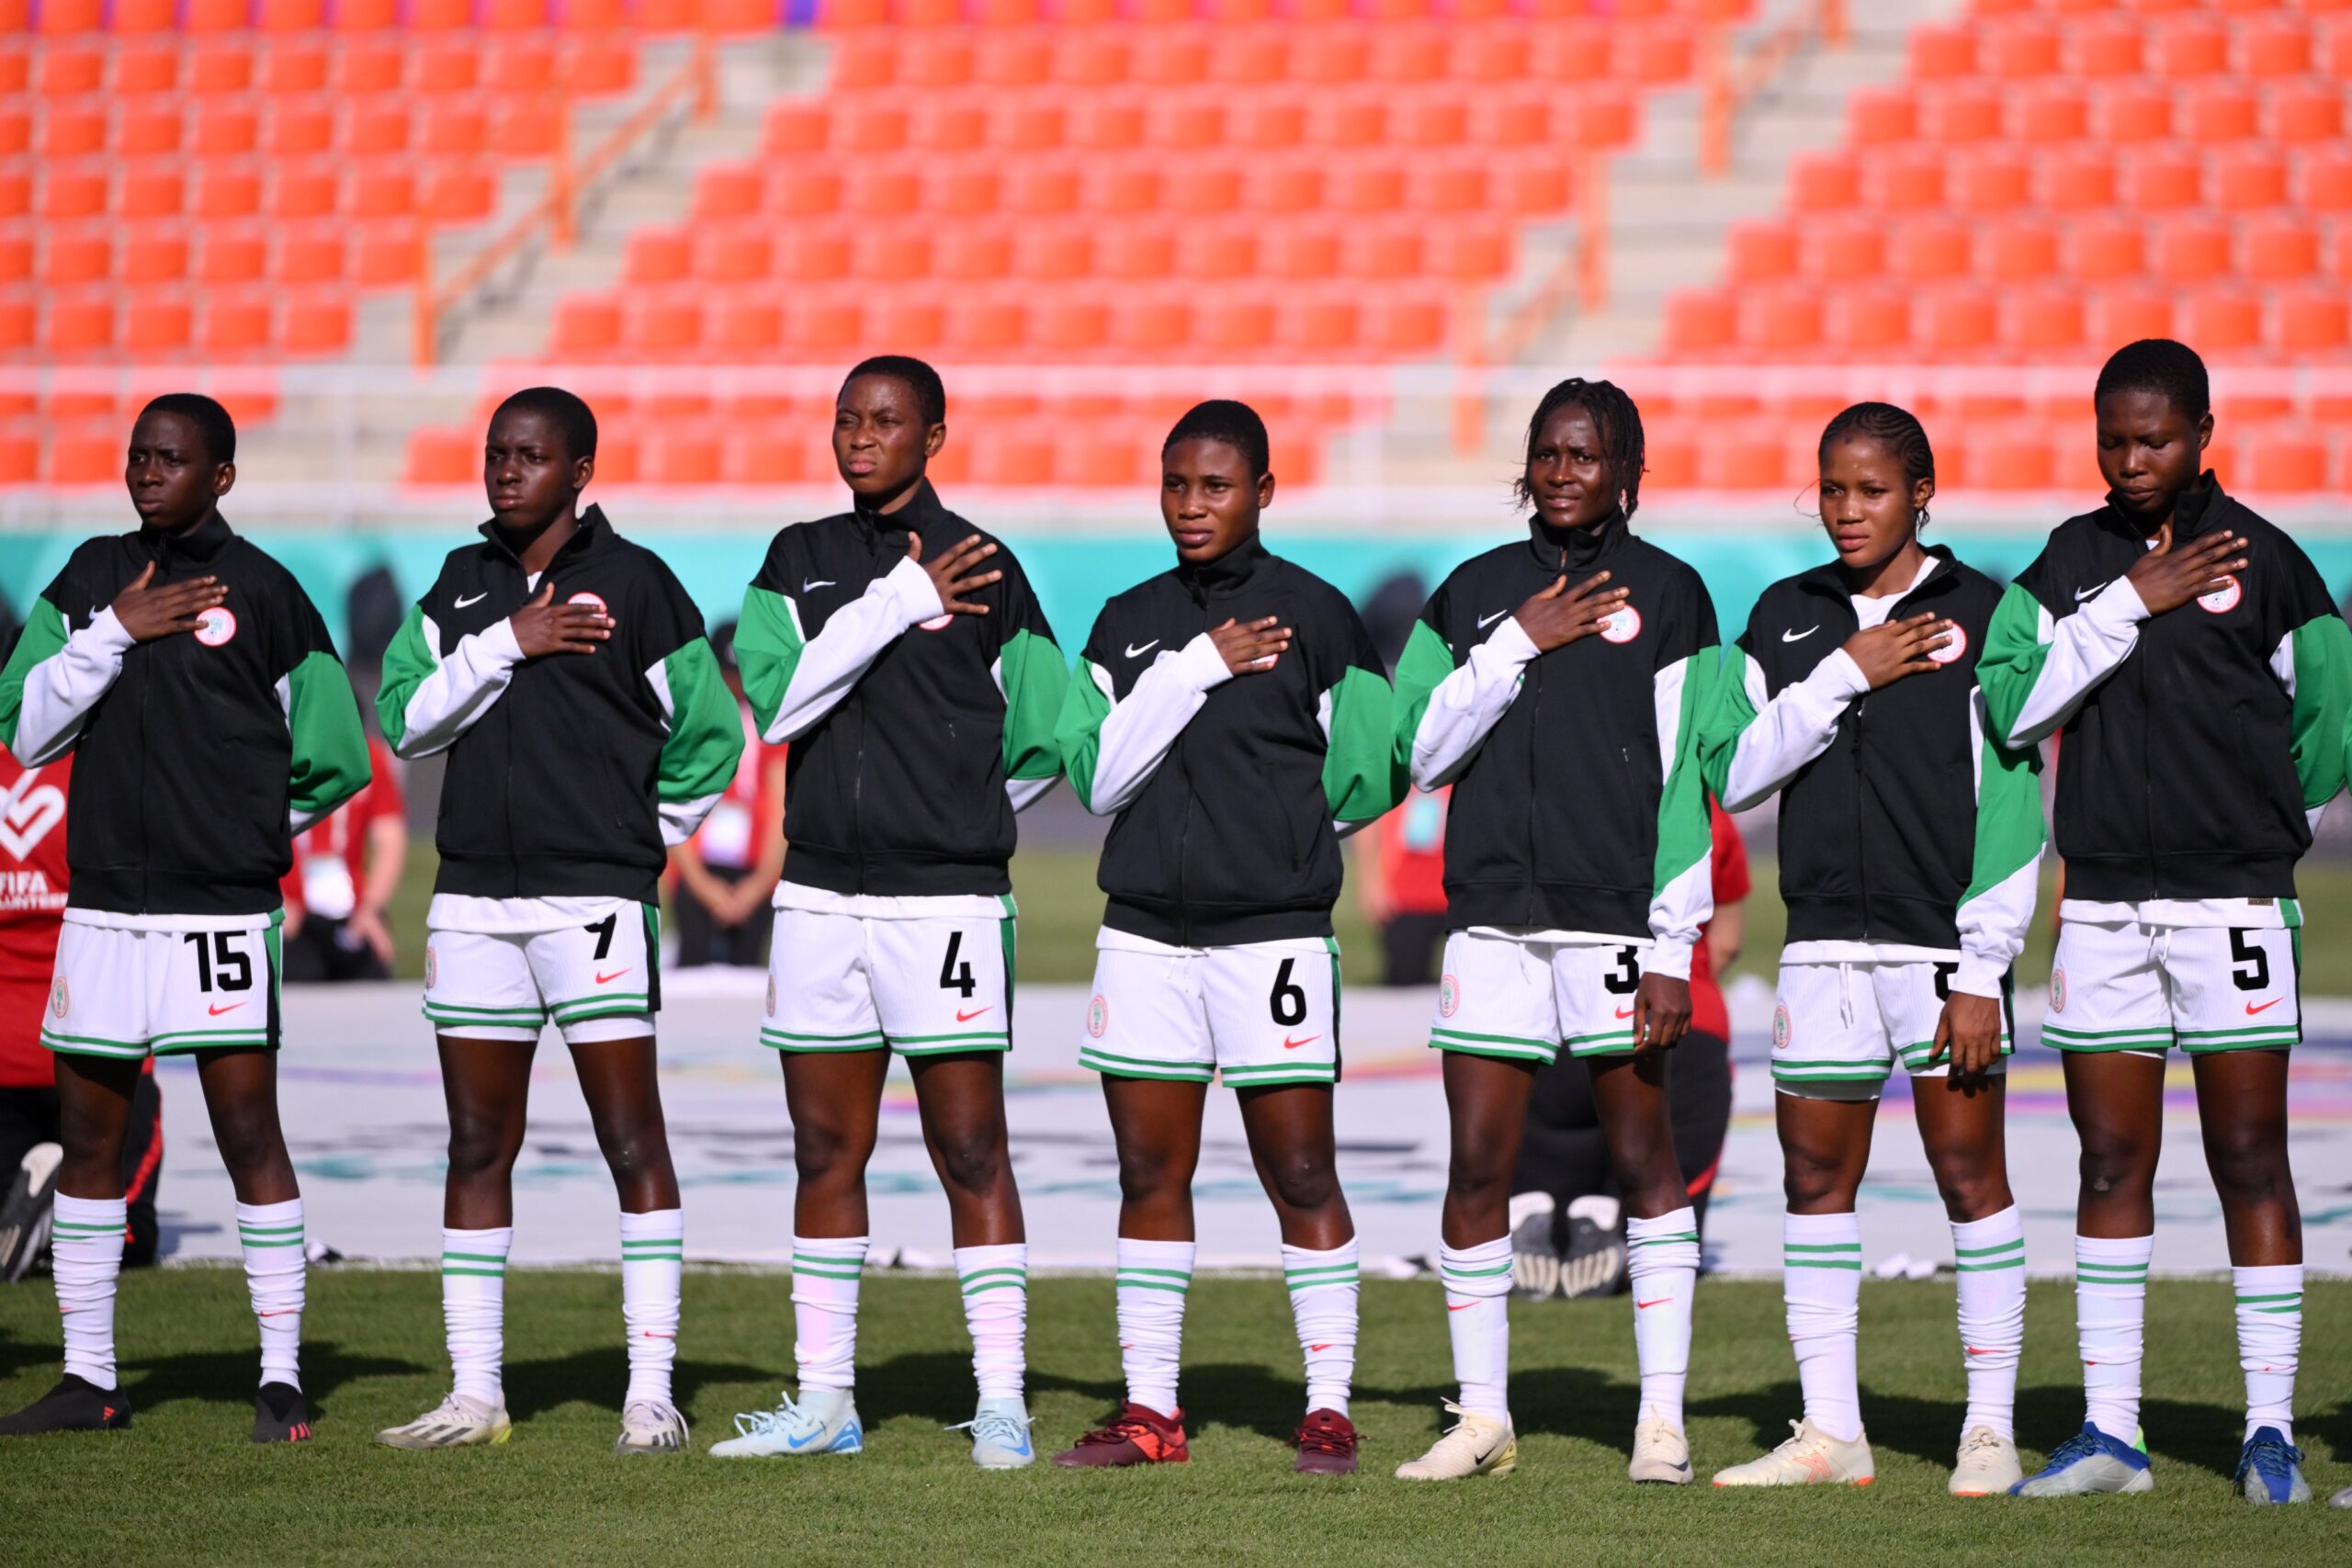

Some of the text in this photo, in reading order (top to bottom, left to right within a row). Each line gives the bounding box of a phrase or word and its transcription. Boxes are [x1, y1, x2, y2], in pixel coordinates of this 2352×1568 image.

[184, 931, 253, 992] 15
[940, 931, 976, 998] 4
[1601, 942, 1640, 994] 3
[2229, 927, 2269, 991] 5
[1270, 957, 1306, 1026] 6
